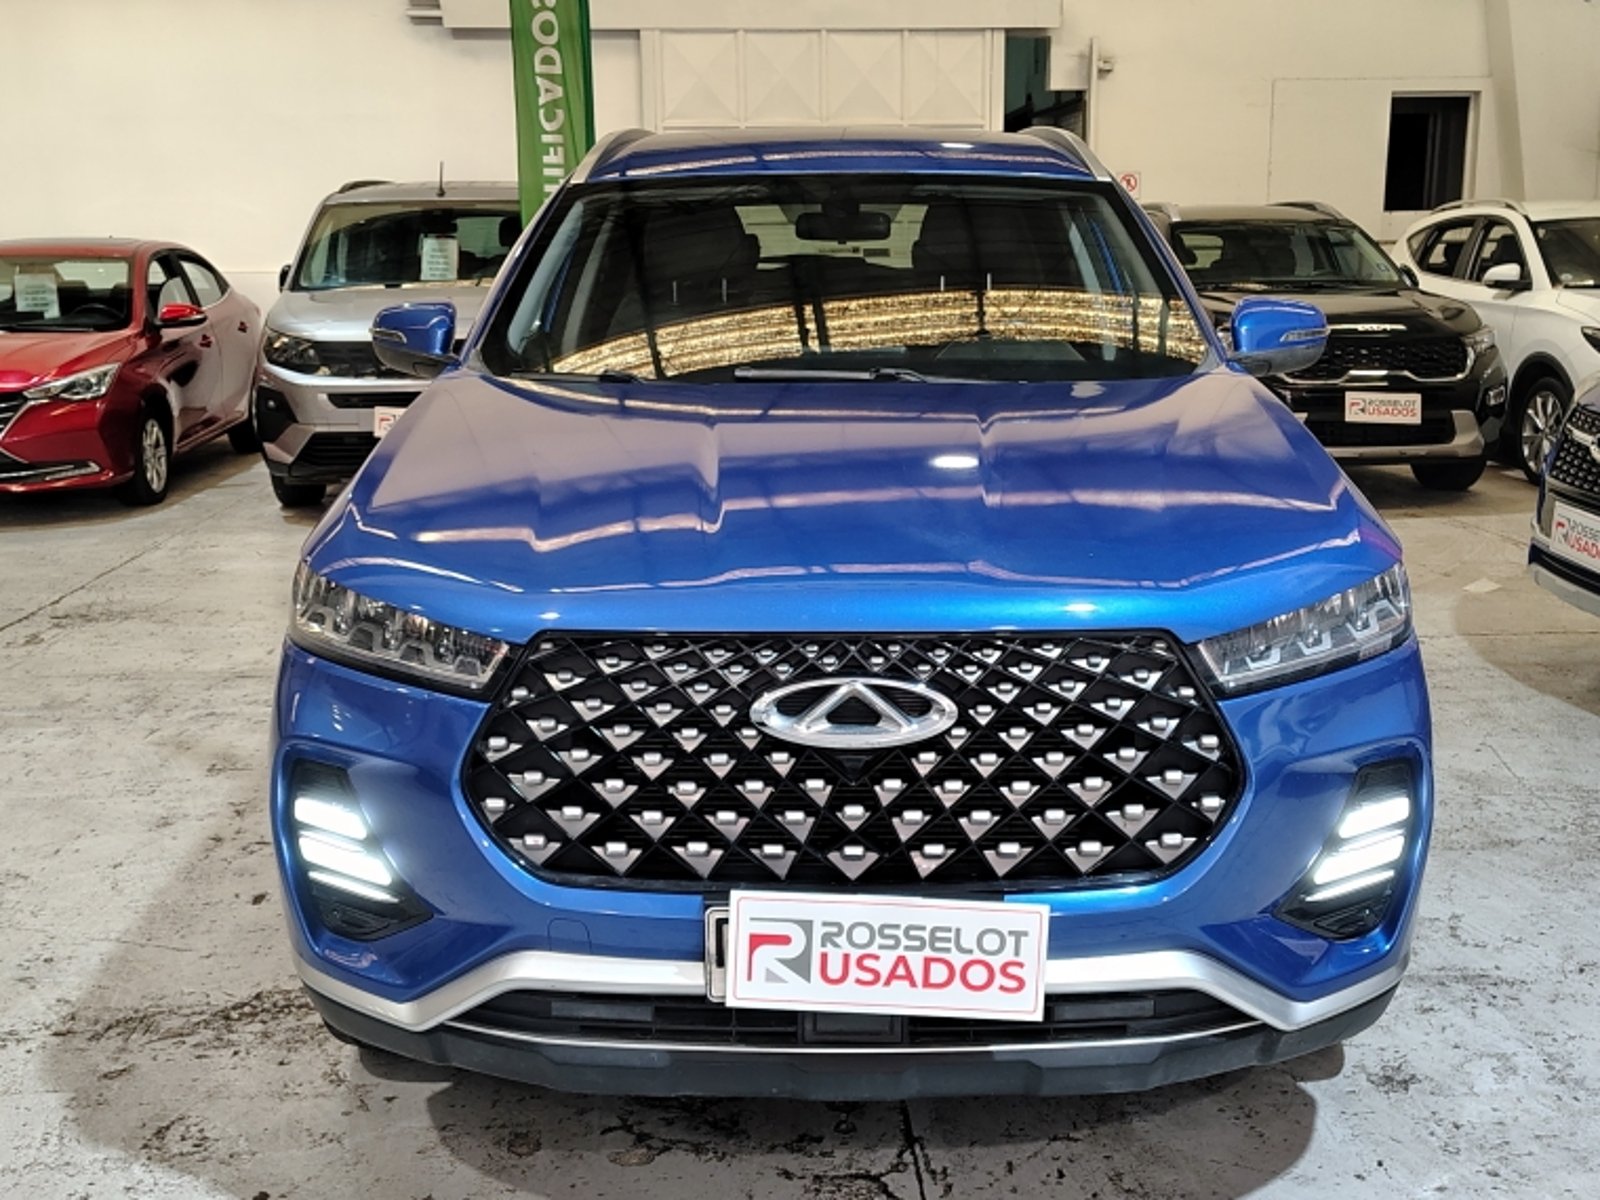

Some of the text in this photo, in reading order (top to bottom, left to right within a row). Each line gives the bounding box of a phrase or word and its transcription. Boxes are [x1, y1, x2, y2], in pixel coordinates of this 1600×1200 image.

[1367, 407, 1417, 418] USADOS
[820, 921, 1029, 958] ROSSELOT
[819, 951, 1027, 995] USADOS
